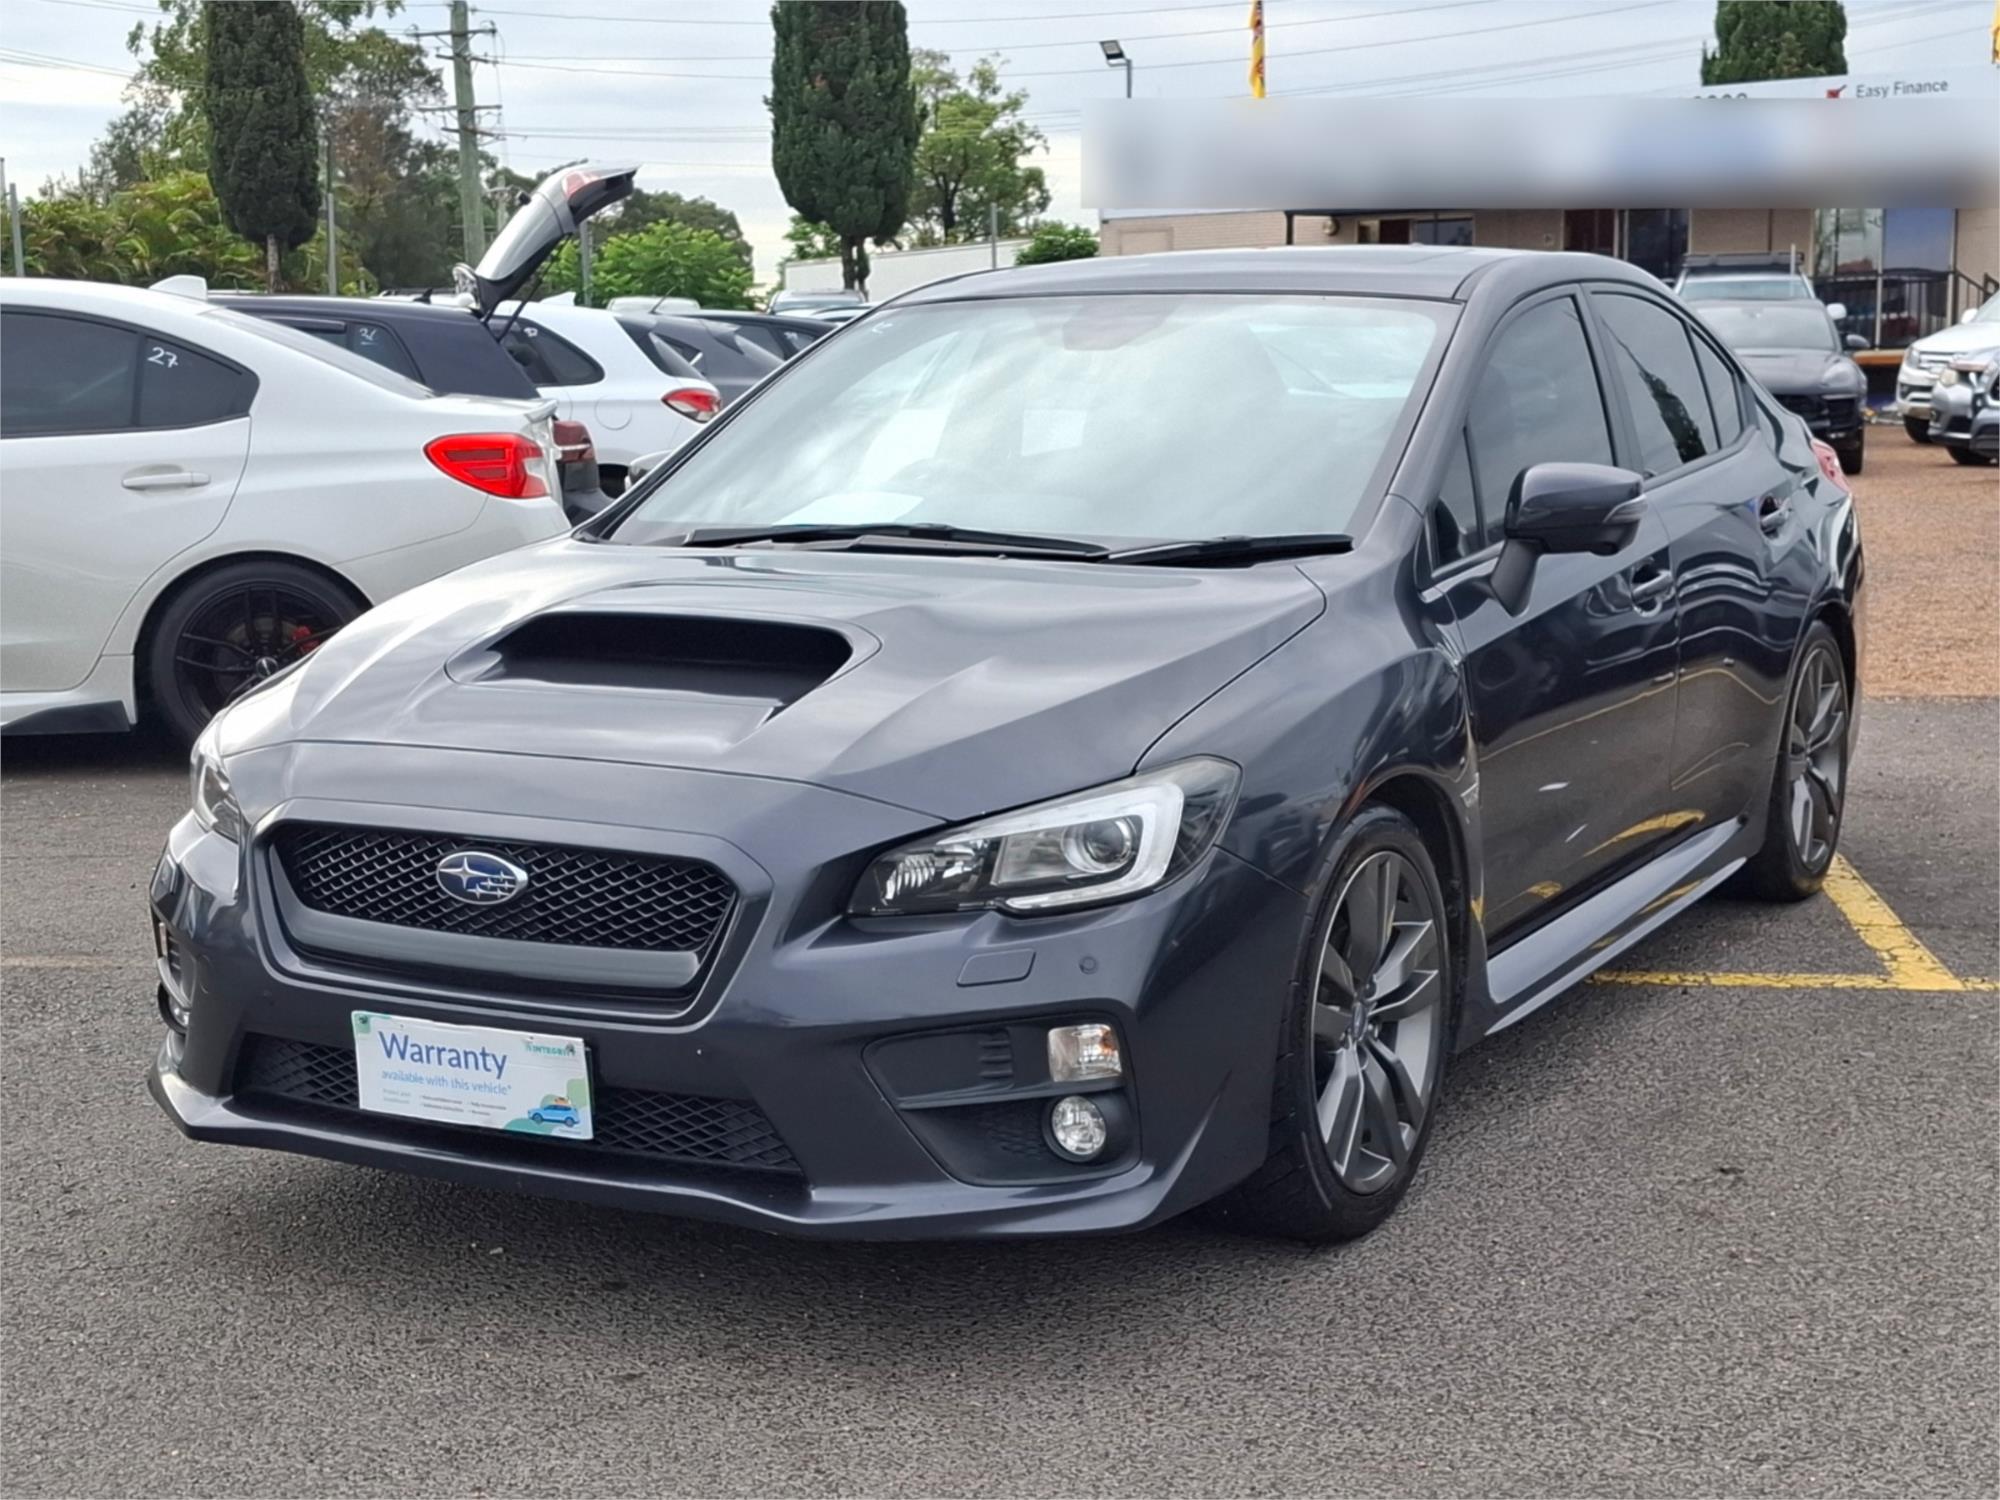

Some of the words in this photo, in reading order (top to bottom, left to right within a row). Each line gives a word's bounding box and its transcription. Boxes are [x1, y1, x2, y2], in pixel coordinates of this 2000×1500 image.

[1856, 84, 1889, 99] Easy
[1893, 81, 1948, 97] Finance
[147, 346, 179, 368] 27
[378, 1030, 507, 1080] Warranty
[382, 1069, 424, 1085] available
[425, 1074, 449, 1088] with
[451, 1078, 470, 1092] this
